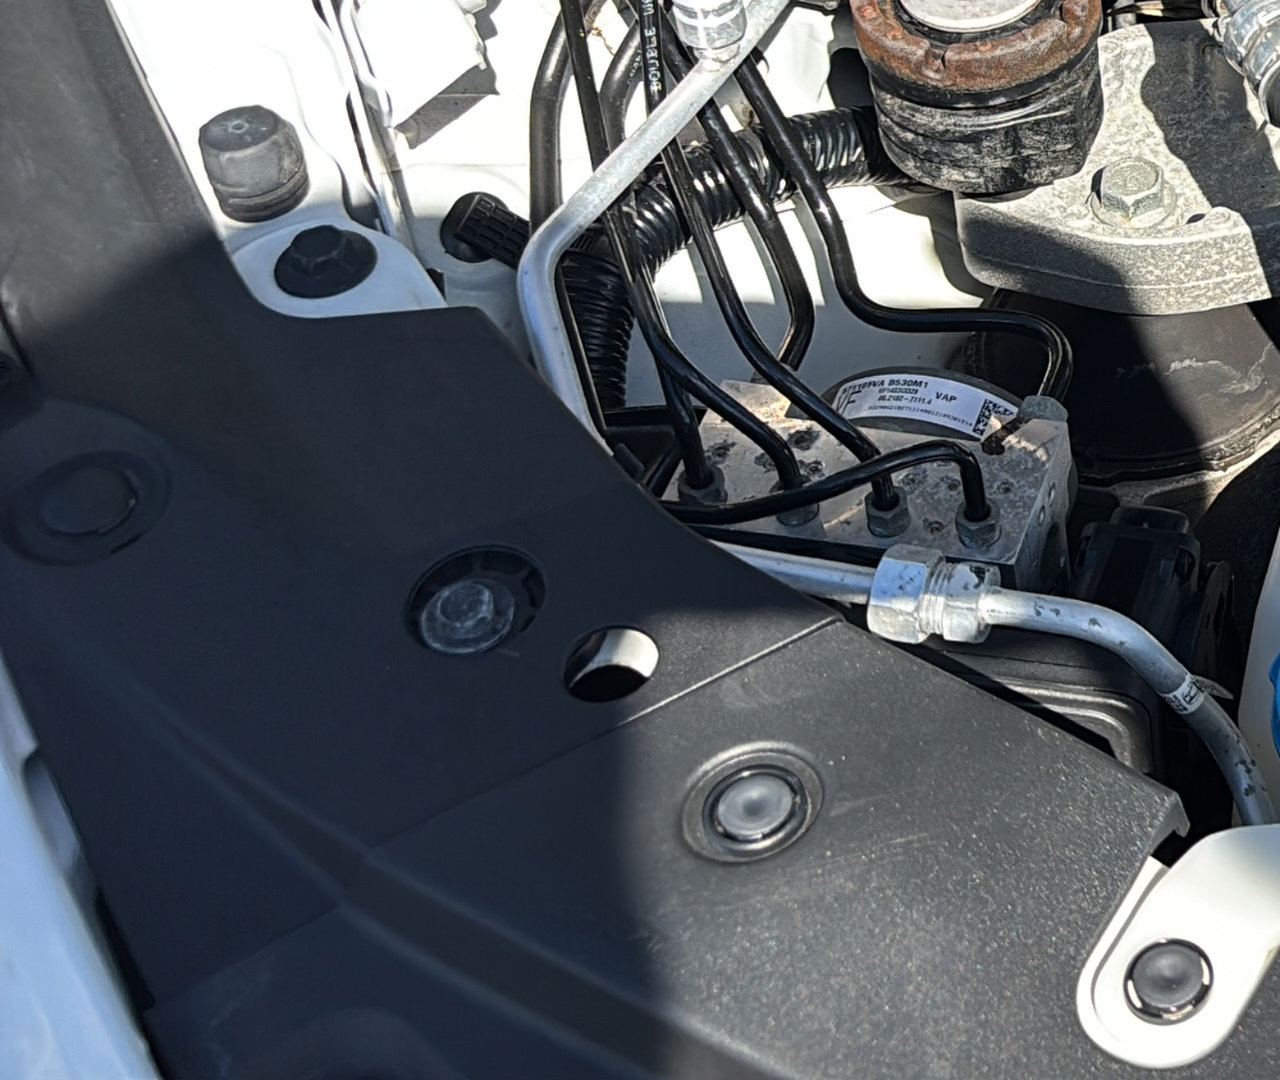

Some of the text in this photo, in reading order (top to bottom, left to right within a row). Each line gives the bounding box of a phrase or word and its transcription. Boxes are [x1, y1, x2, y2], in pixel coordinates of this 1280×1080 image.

[644, 26, 663, 93] DOUBLE
[888, 379, 929, 388] B530M1
[935, 392, 957, 403] VAP
